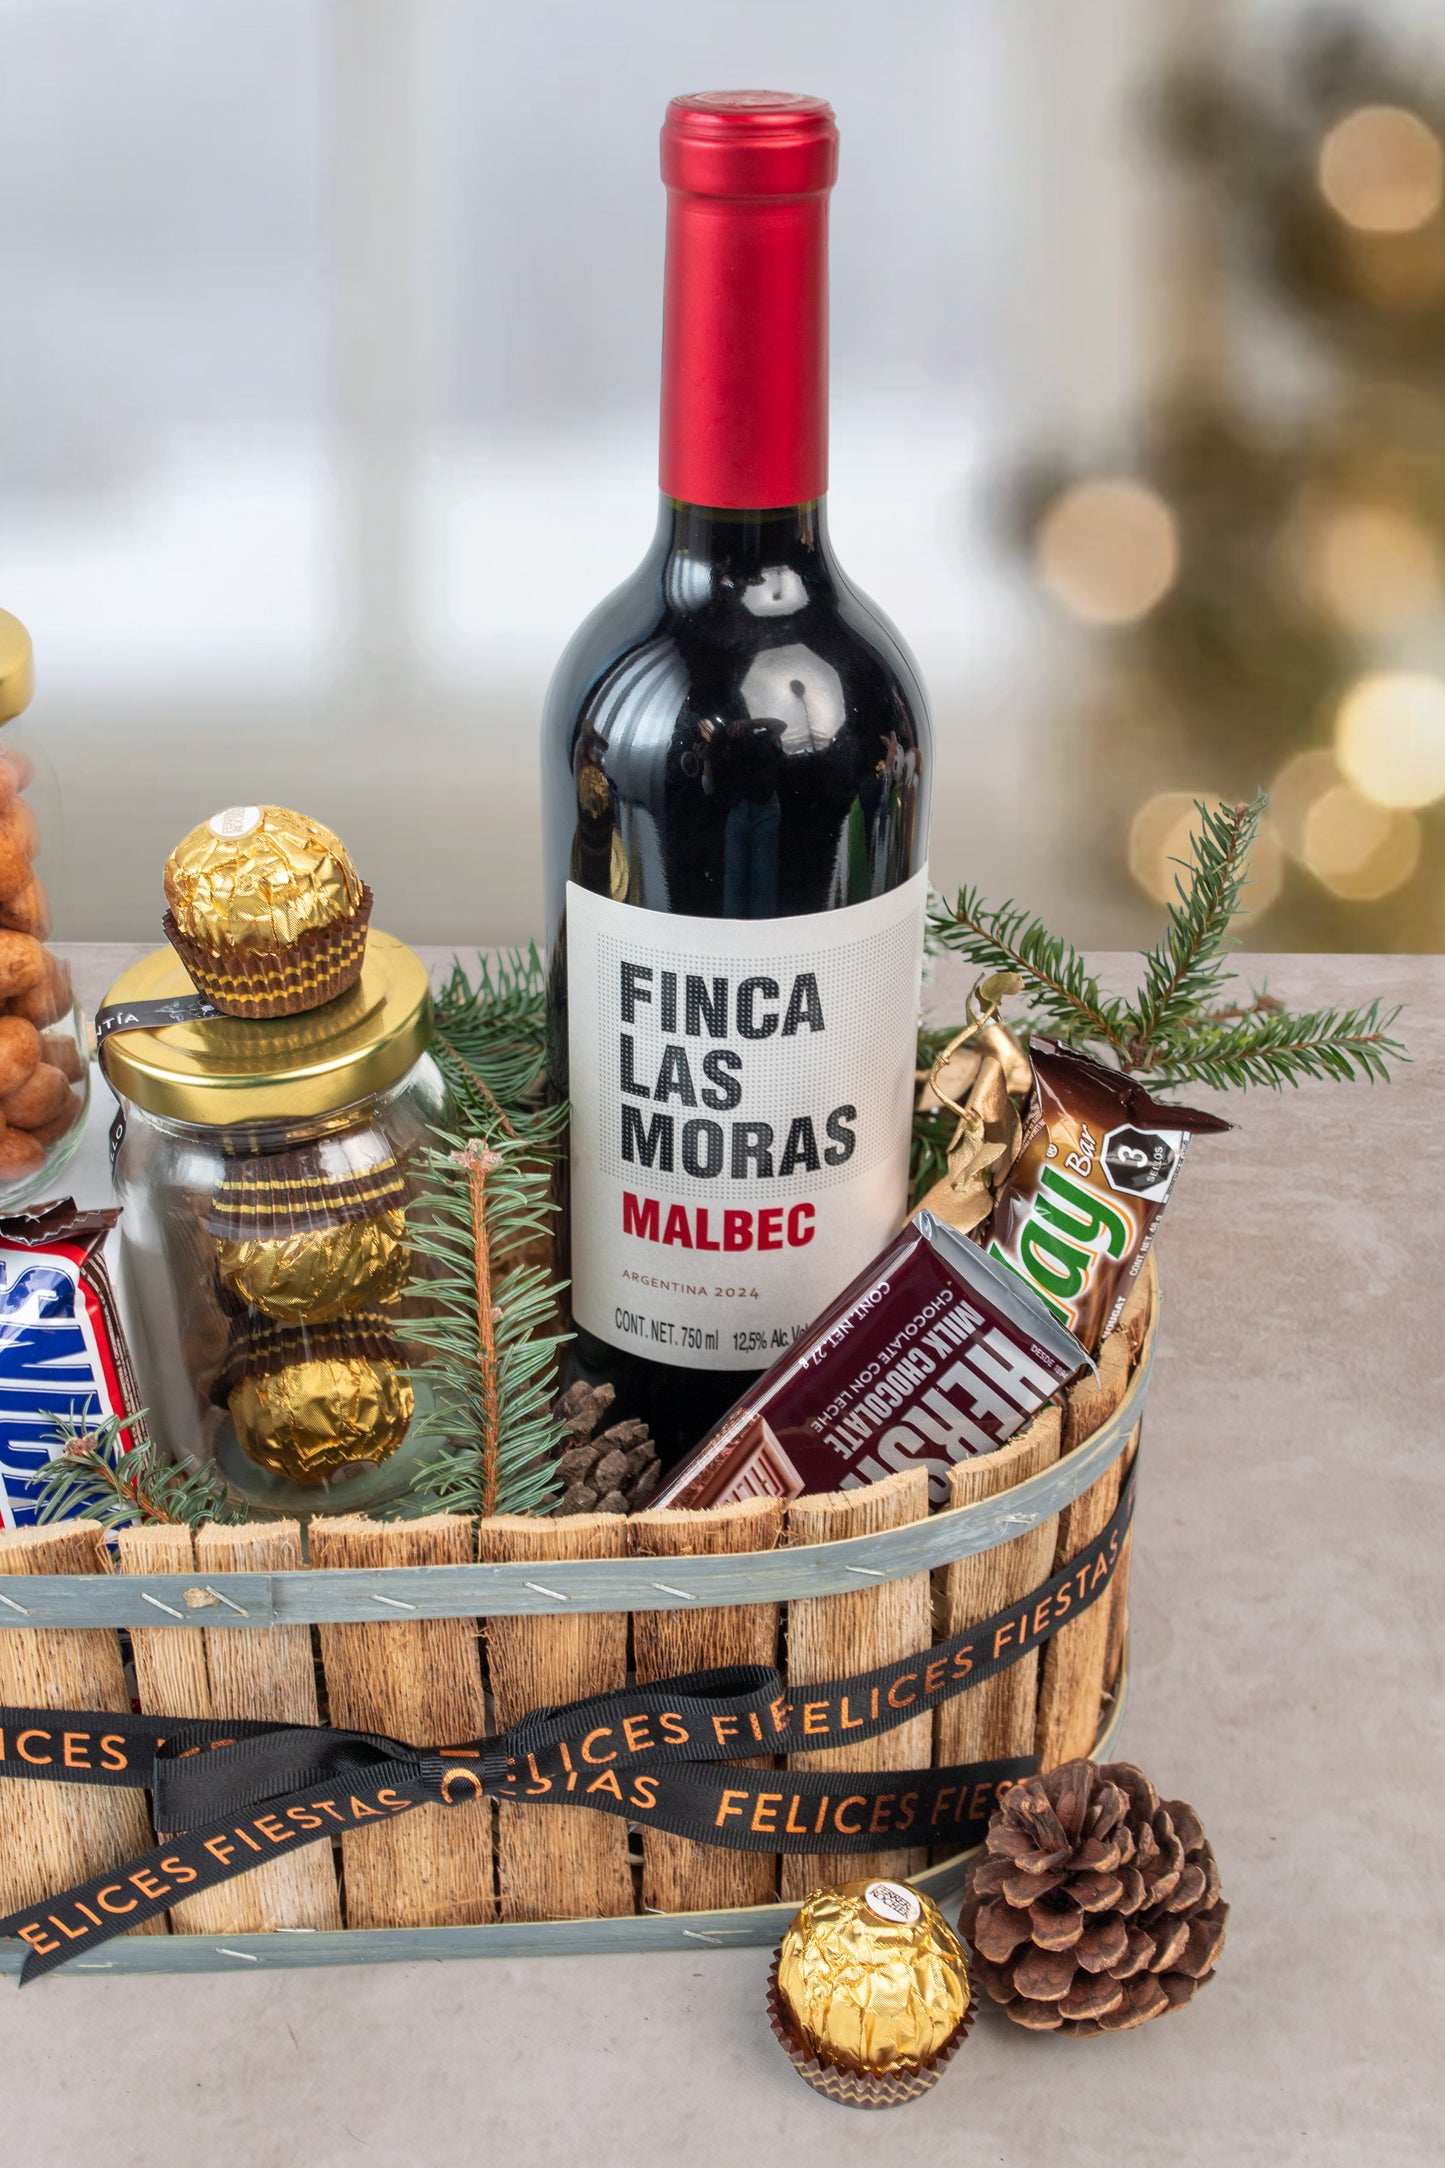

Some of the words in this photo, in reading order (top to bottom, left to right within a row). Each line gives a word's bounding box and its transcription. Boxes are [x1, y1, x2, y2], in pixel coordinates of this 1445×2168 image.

[620, 960, 826, 1040] FINCA
[619, 1032, 743, 1111] LAS
[620, 1103, 857, 1180] MORAS
[1064, 1122, 1098, 1178] Bar
[1117, 1144, 1149, 1168] 3
[1146, 1146, 1164, 1183] SELLOS
[622, 1191, 816, 1252] MALBEC
[622, 1269, 708, 1296] ARGENTINA
[714, 1287, 760, 1300] 2024
[841, 1280, 891, 1322] CONT.
[615, 1307, 648, 1339] CONT.
[651, 1319, 678, 1346] NET.
[681, 1326, 702, 1350] 750
[705, 1329, 719, 1350] ml
[733, 1331, 767, 1354] 12,5%
[823, 1315, 855, 1349] NET.
[879, 1289, 954, 1366] CHOCOLATE
[921, 1300, 985, 1359] MILK
[1030, 1343, 1056, 1368] DESDE
[812, 1346, 828, 1366] 27
[849, 1363, 881, 1395] CON
[810, 1391, 853, 1434] LECHE
[823, 1348, 936, 1461] CHOCOLATE
[786, 1646, 973, 1736] ELICES
[993, 1528, 1119, 1660] FIESTAS
[506, 1712, 690, 1782] LICES
[203, 1788, 412, 1866] FIESTAS
[714, 1789, 919, 1835] FELICES
[931, 1777, 1029, 1825] FIES
[868, 1888, 910, 1920] ROCHER
